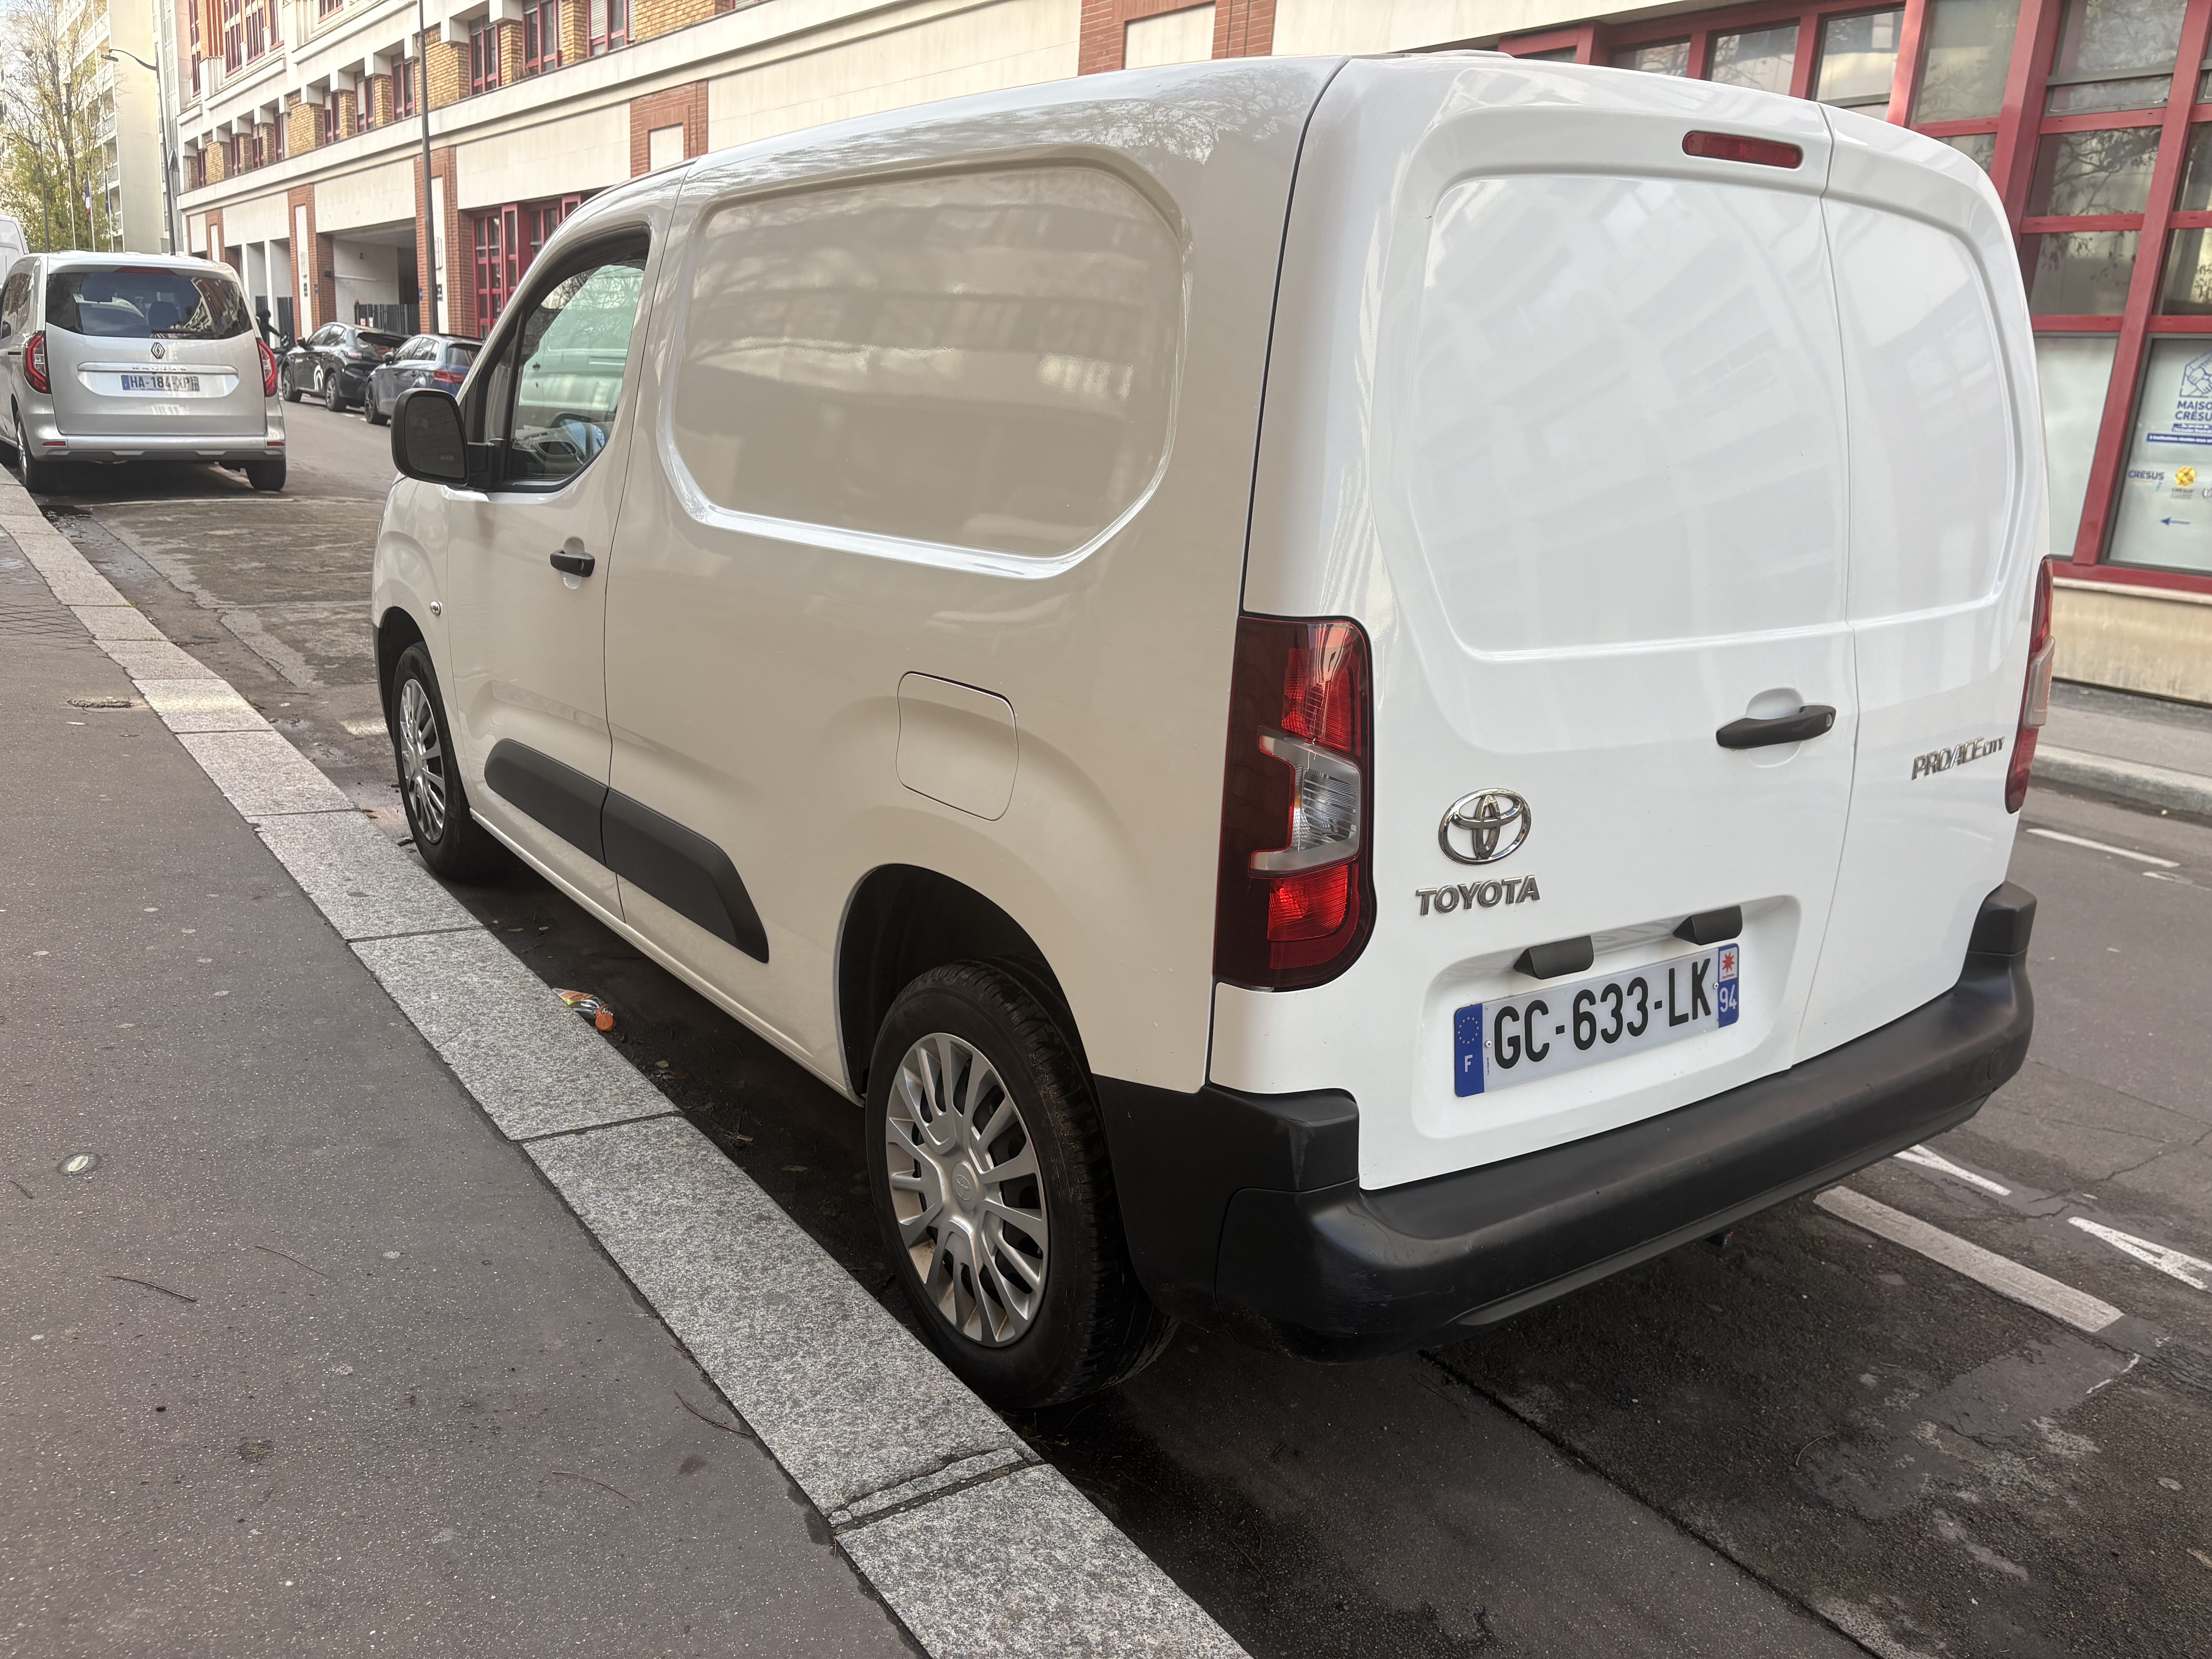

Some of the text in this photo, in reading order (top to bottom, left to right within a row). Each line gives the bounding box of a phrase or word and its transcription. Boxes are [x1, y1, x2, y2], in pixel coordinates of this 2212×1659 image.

[1911, 736, 2005, 780] PROACE CITY
[1416, 875, 1540, 915] TOYOTA
[1494, 958, 1711, 1069] GC-633-LK
[1719, 984, 1737, 1013] 94
[1465, 1054, 1473, 1073] F
